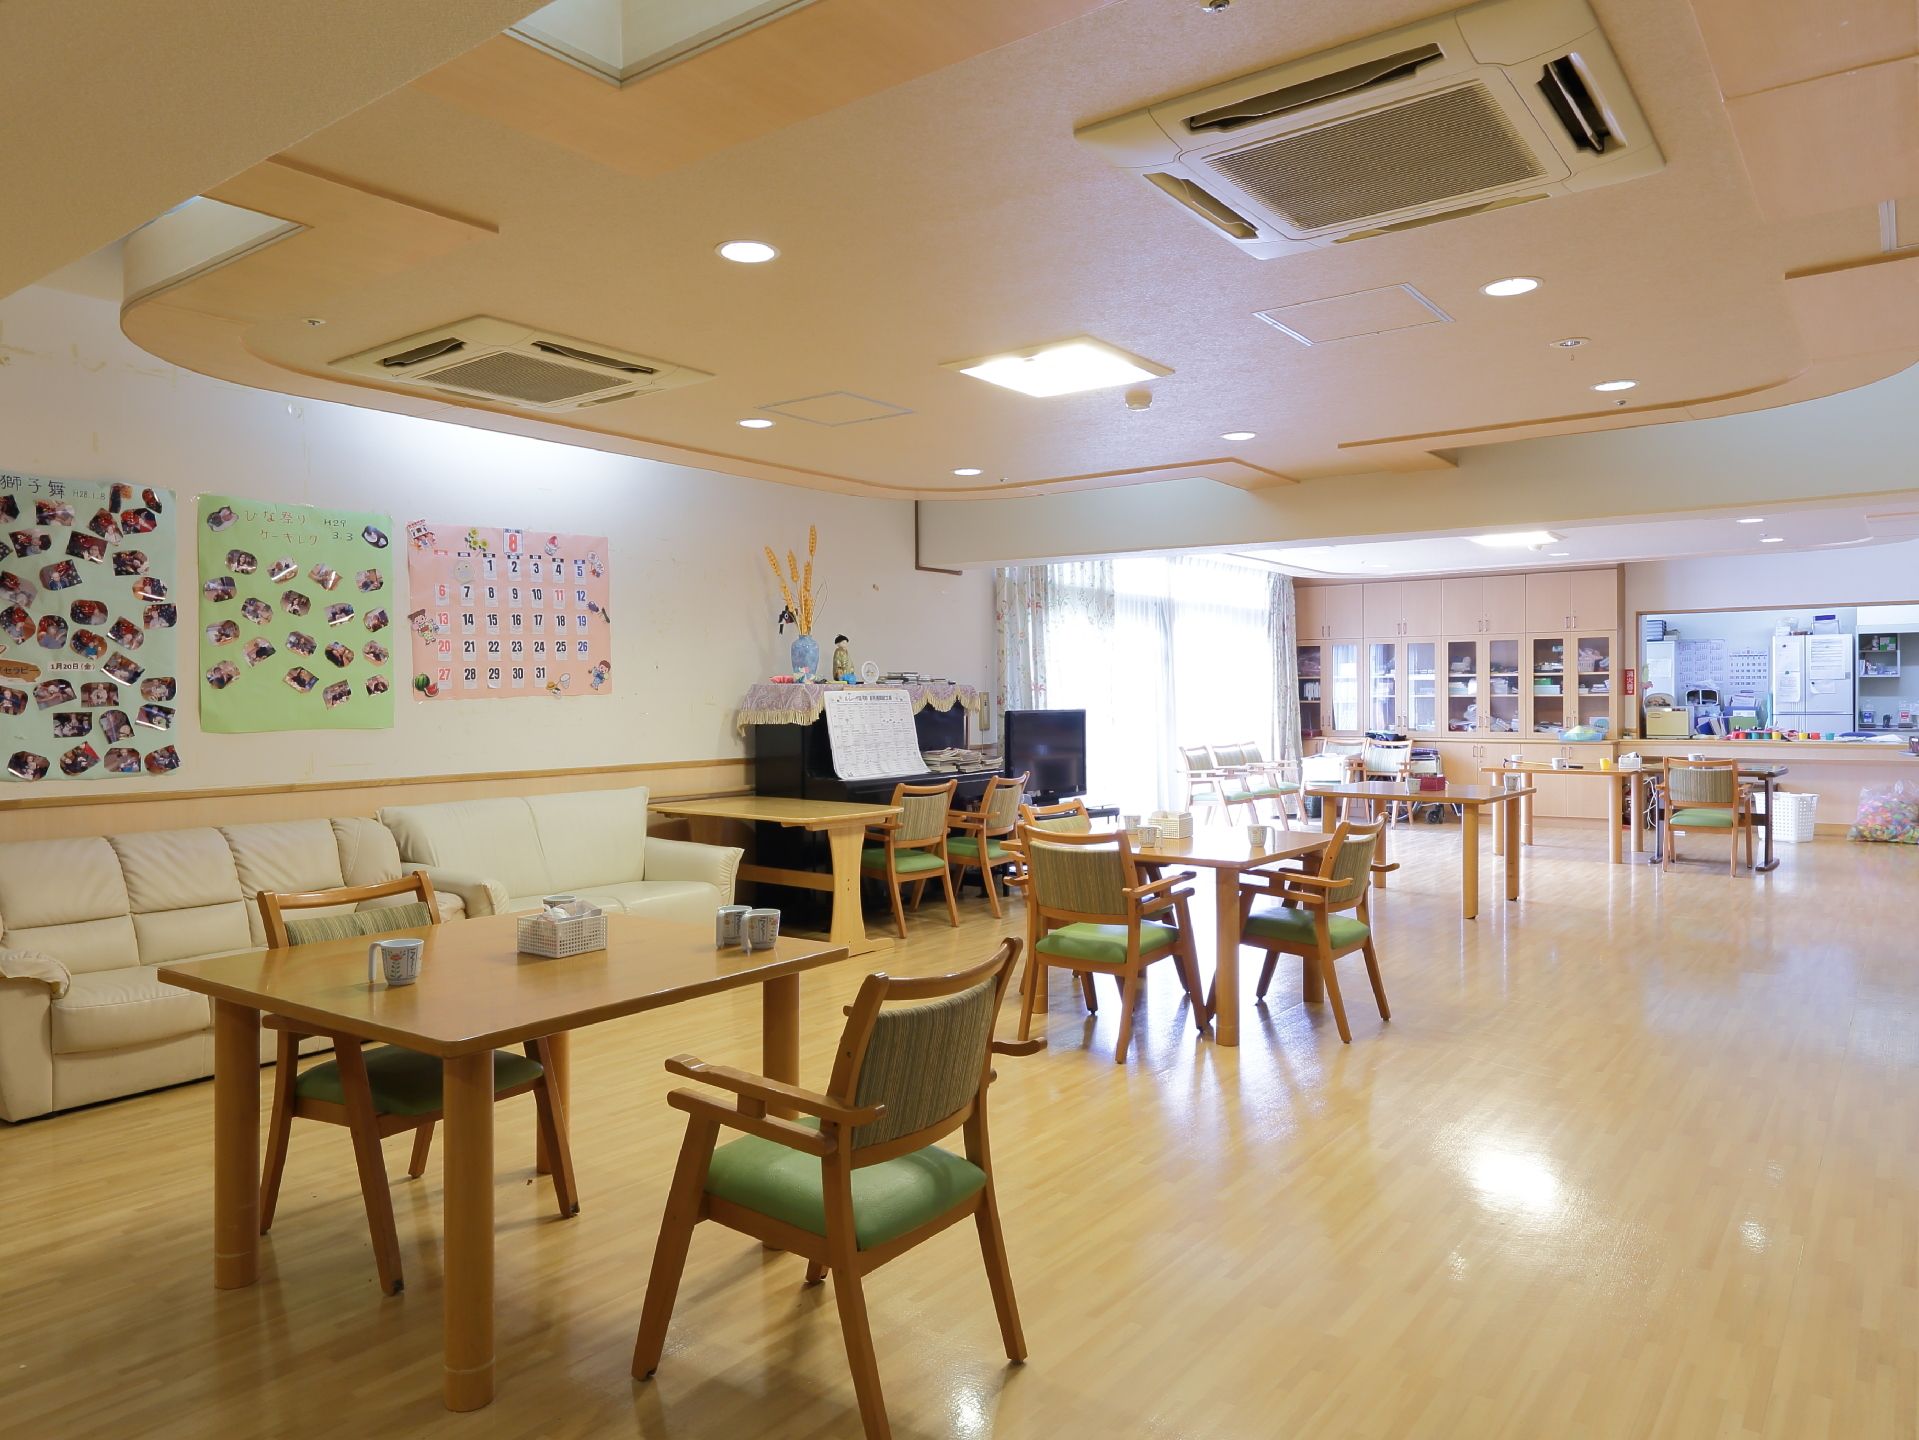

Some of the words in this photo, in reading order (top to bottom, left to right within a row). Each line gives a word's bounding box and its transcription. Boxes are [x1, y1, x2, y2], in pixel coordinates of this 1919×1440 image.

[0, 474, 66, 499] 獅子舞
[245, 508, 306, 525] ひな祭り
[323, 518, 347, 527] H29
[509, 533, 517, 553] 8
[487, 559, 493, 571] 1
[511, 561, 518, 573] 2
[534, 563, 539, 574] 3
[555, 563, 562, 575] 4
[577, 566, 583, 577] 5
[439, 585, 446, 597] 6
[463, 586, 470, 598] 7
[488, 587, 495, 599] 8
[512, 588, 518, 600] 9
[532, 589, 542, 600] 10
[555, 589, 563, 601] 11
[576, 591, 585, 602] 12
[438, 612, 448, 625] 13
[462, 613, 474, 625] 14
[487, 614, 498, 625] 15
[512, 614, 522, 626] 16
[534, 615, 543, 626] 17
[556, 615, 566, 626] 18
[577, 616, 586, 626] 19
[439, 641, 450, 652] 20
[464, 641, 475, 652] 21
[488, 641, 500, 652] 22
[511, 641, 522, 652] 23
[534, 642, 545, 652] 24
[556, 641, 567, 652] 25
[578, 641, 588, 651] 26
[439, 668, 450, 681] 27
[464, 668, 476, 680] 28
[488, 668, 500, 680] 29
[512, 668, 524, 680] 30
[535, 667, 545, 679] 31
